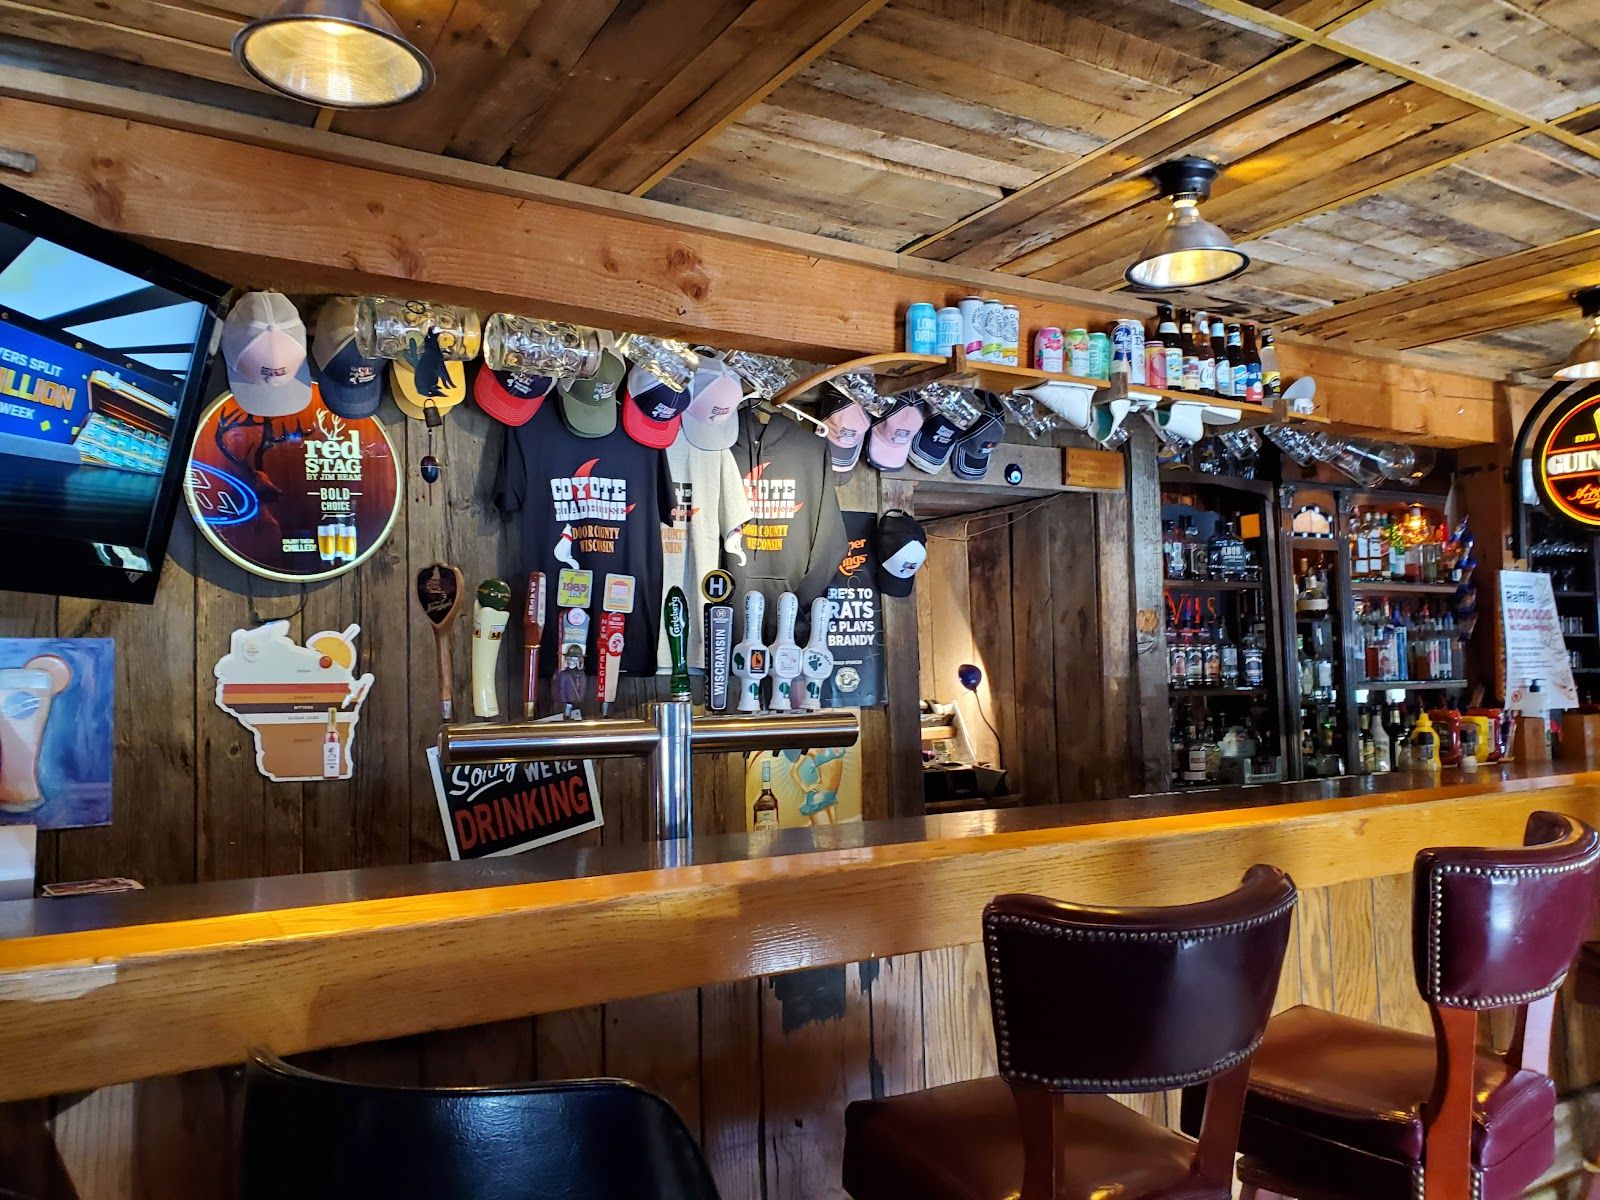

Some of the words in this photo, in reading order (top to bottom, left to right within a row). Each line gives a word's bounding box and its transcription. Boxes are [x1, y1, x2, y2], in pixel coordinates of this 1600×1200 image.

[29, 358, 63, 377] SPLIT
[304, 430, 363, 459] red
[305, 459, 362, 474] STAG
[320, 488, 350, 500] BOLD
[550, 477, 627, 501] COYOTE
[321, 501, 351, 511] CHOICE
[553, 499, 627, 522] ROADHOUSE
[571, 525, 593, 539] DOOR
[593, 525, 620, 539] COUNTY
[579, 540, 615, 553] WISCONSIN
[709, 577, 724, 596] H
[857, 588, 873, 599] TO
[1506, 591, 1535, 603] Raffle
[670, 596, 683, 637] Carlsberg
[839, 621, 875, 633] PLAYS
[828, 634, 875, 647] BRANDY
[713, 628, 727, 696] WISCRANSIN
[597, 647, 606, 698] BELGIUM
[454, 775, 590, 850] DRINKING
